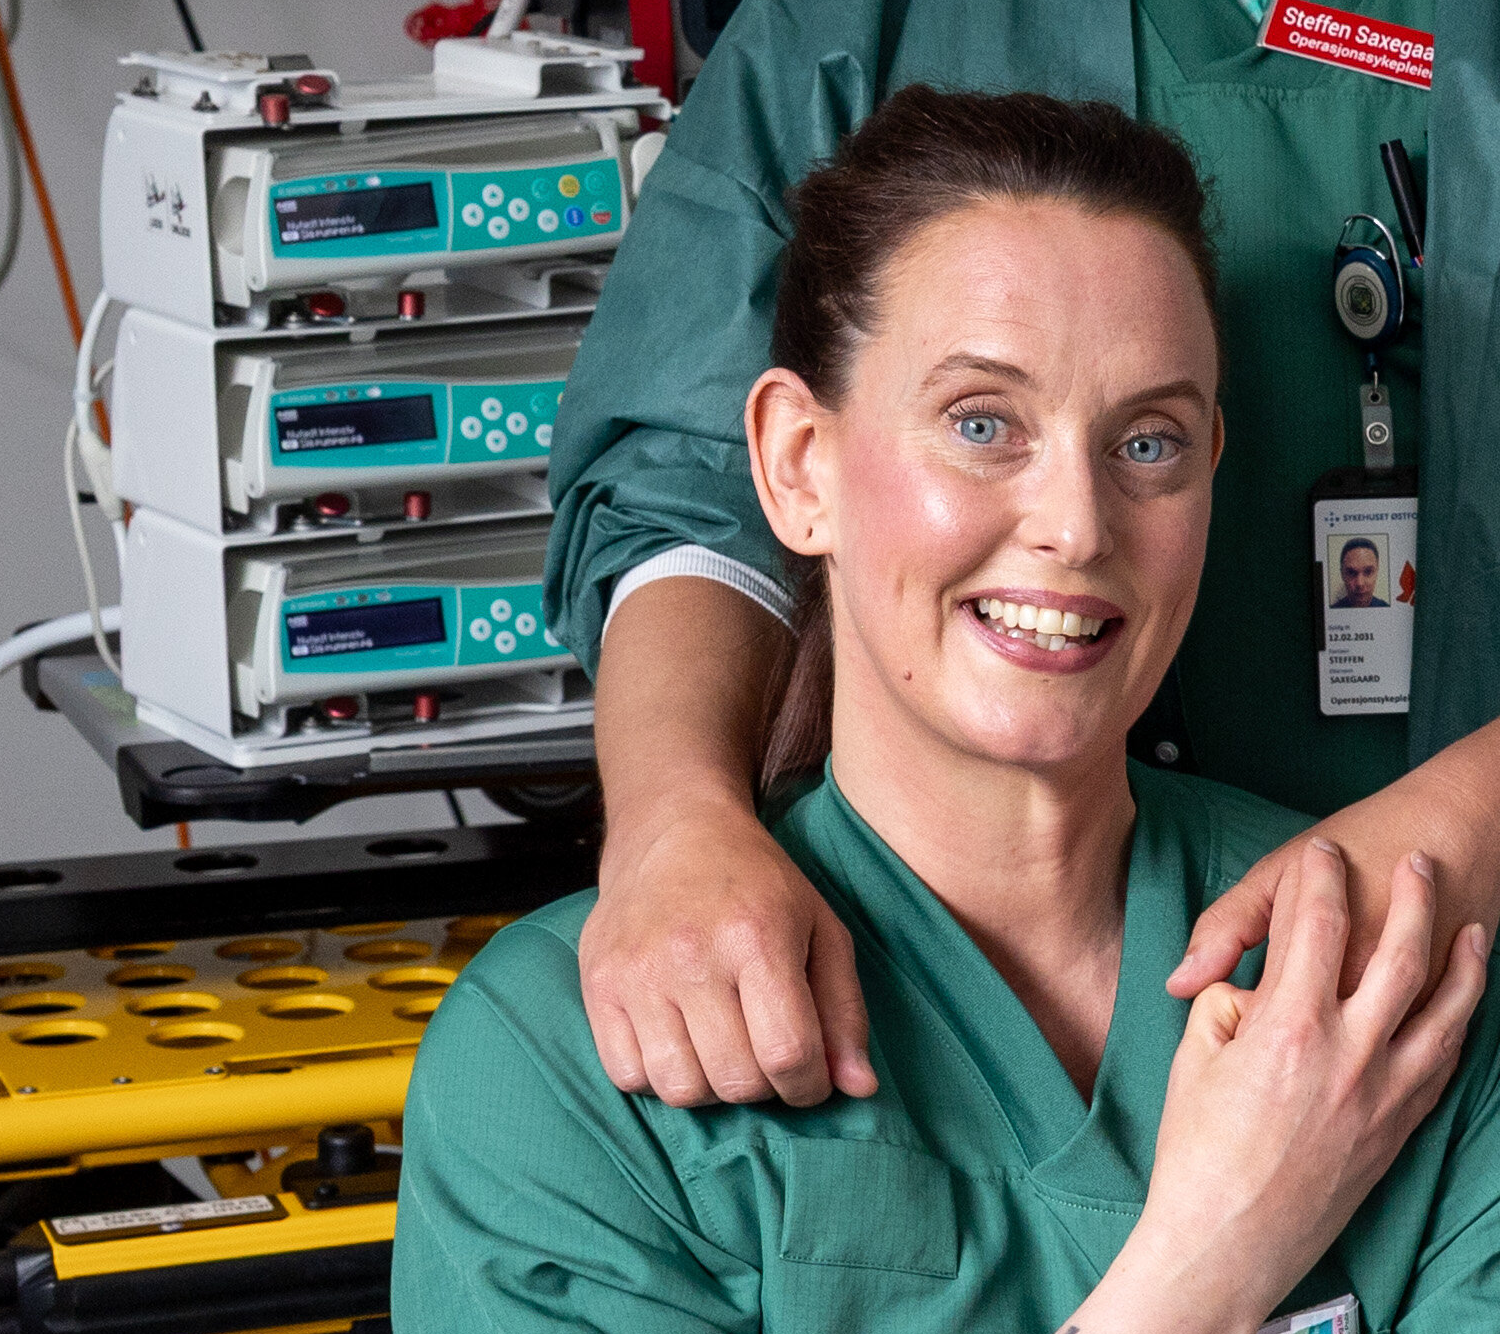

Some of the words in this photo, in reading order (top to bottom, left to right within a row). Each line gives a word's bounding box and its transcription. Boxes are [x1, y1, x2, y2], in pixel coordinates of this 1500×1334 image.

[1283, 7, 1351, 40] Steffen
[1343, 512, 1388, 522] SYKEHUSET
[1328, 632, 1375, 642] 12.02.2031
[1329, 655, 1365, 665] STEFFEN
[1330, 674, 1380, 684] SAXEGAARD
